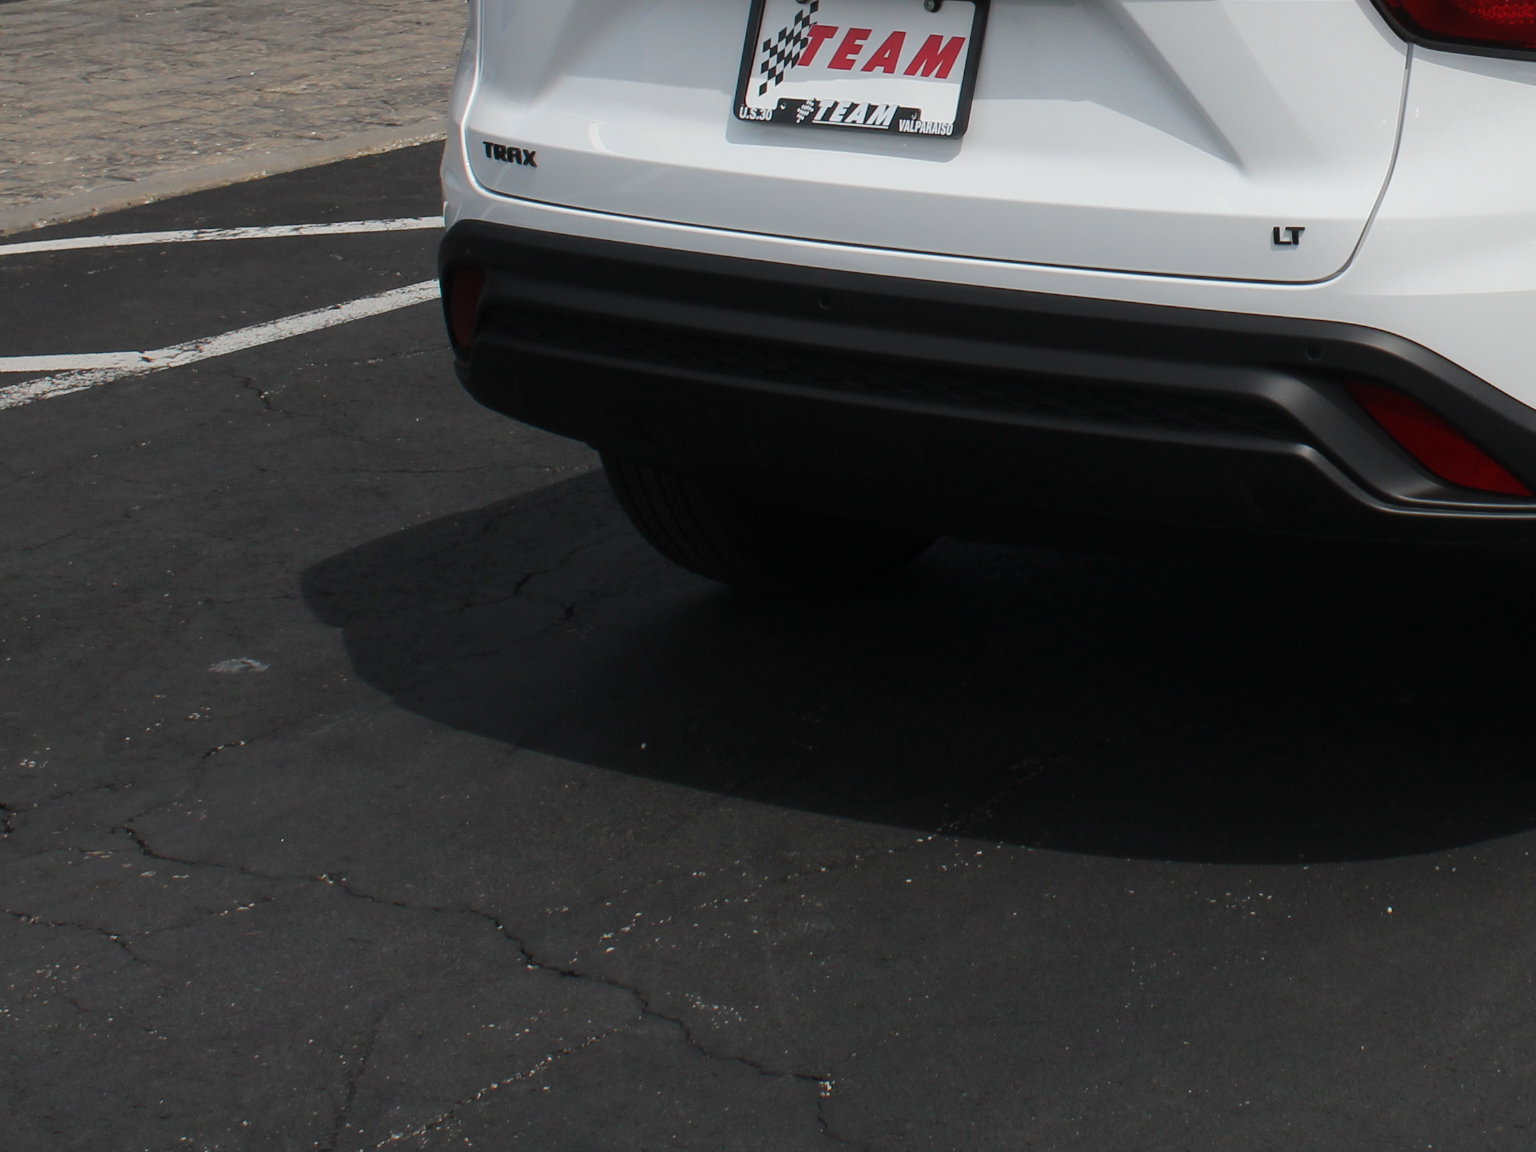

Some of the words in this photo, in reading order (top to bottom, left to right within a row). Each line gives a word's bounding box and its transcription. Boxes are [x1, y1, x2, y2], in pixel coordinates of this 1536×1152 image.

[797, 24, 966, 79] TEAM
[814, 100, 899, 126] TEAM
[898, 119, 953, 136] VALPARAISO
[482, 141, 538, 168] TRAX
[1272, 226, 1306, 245] LT
